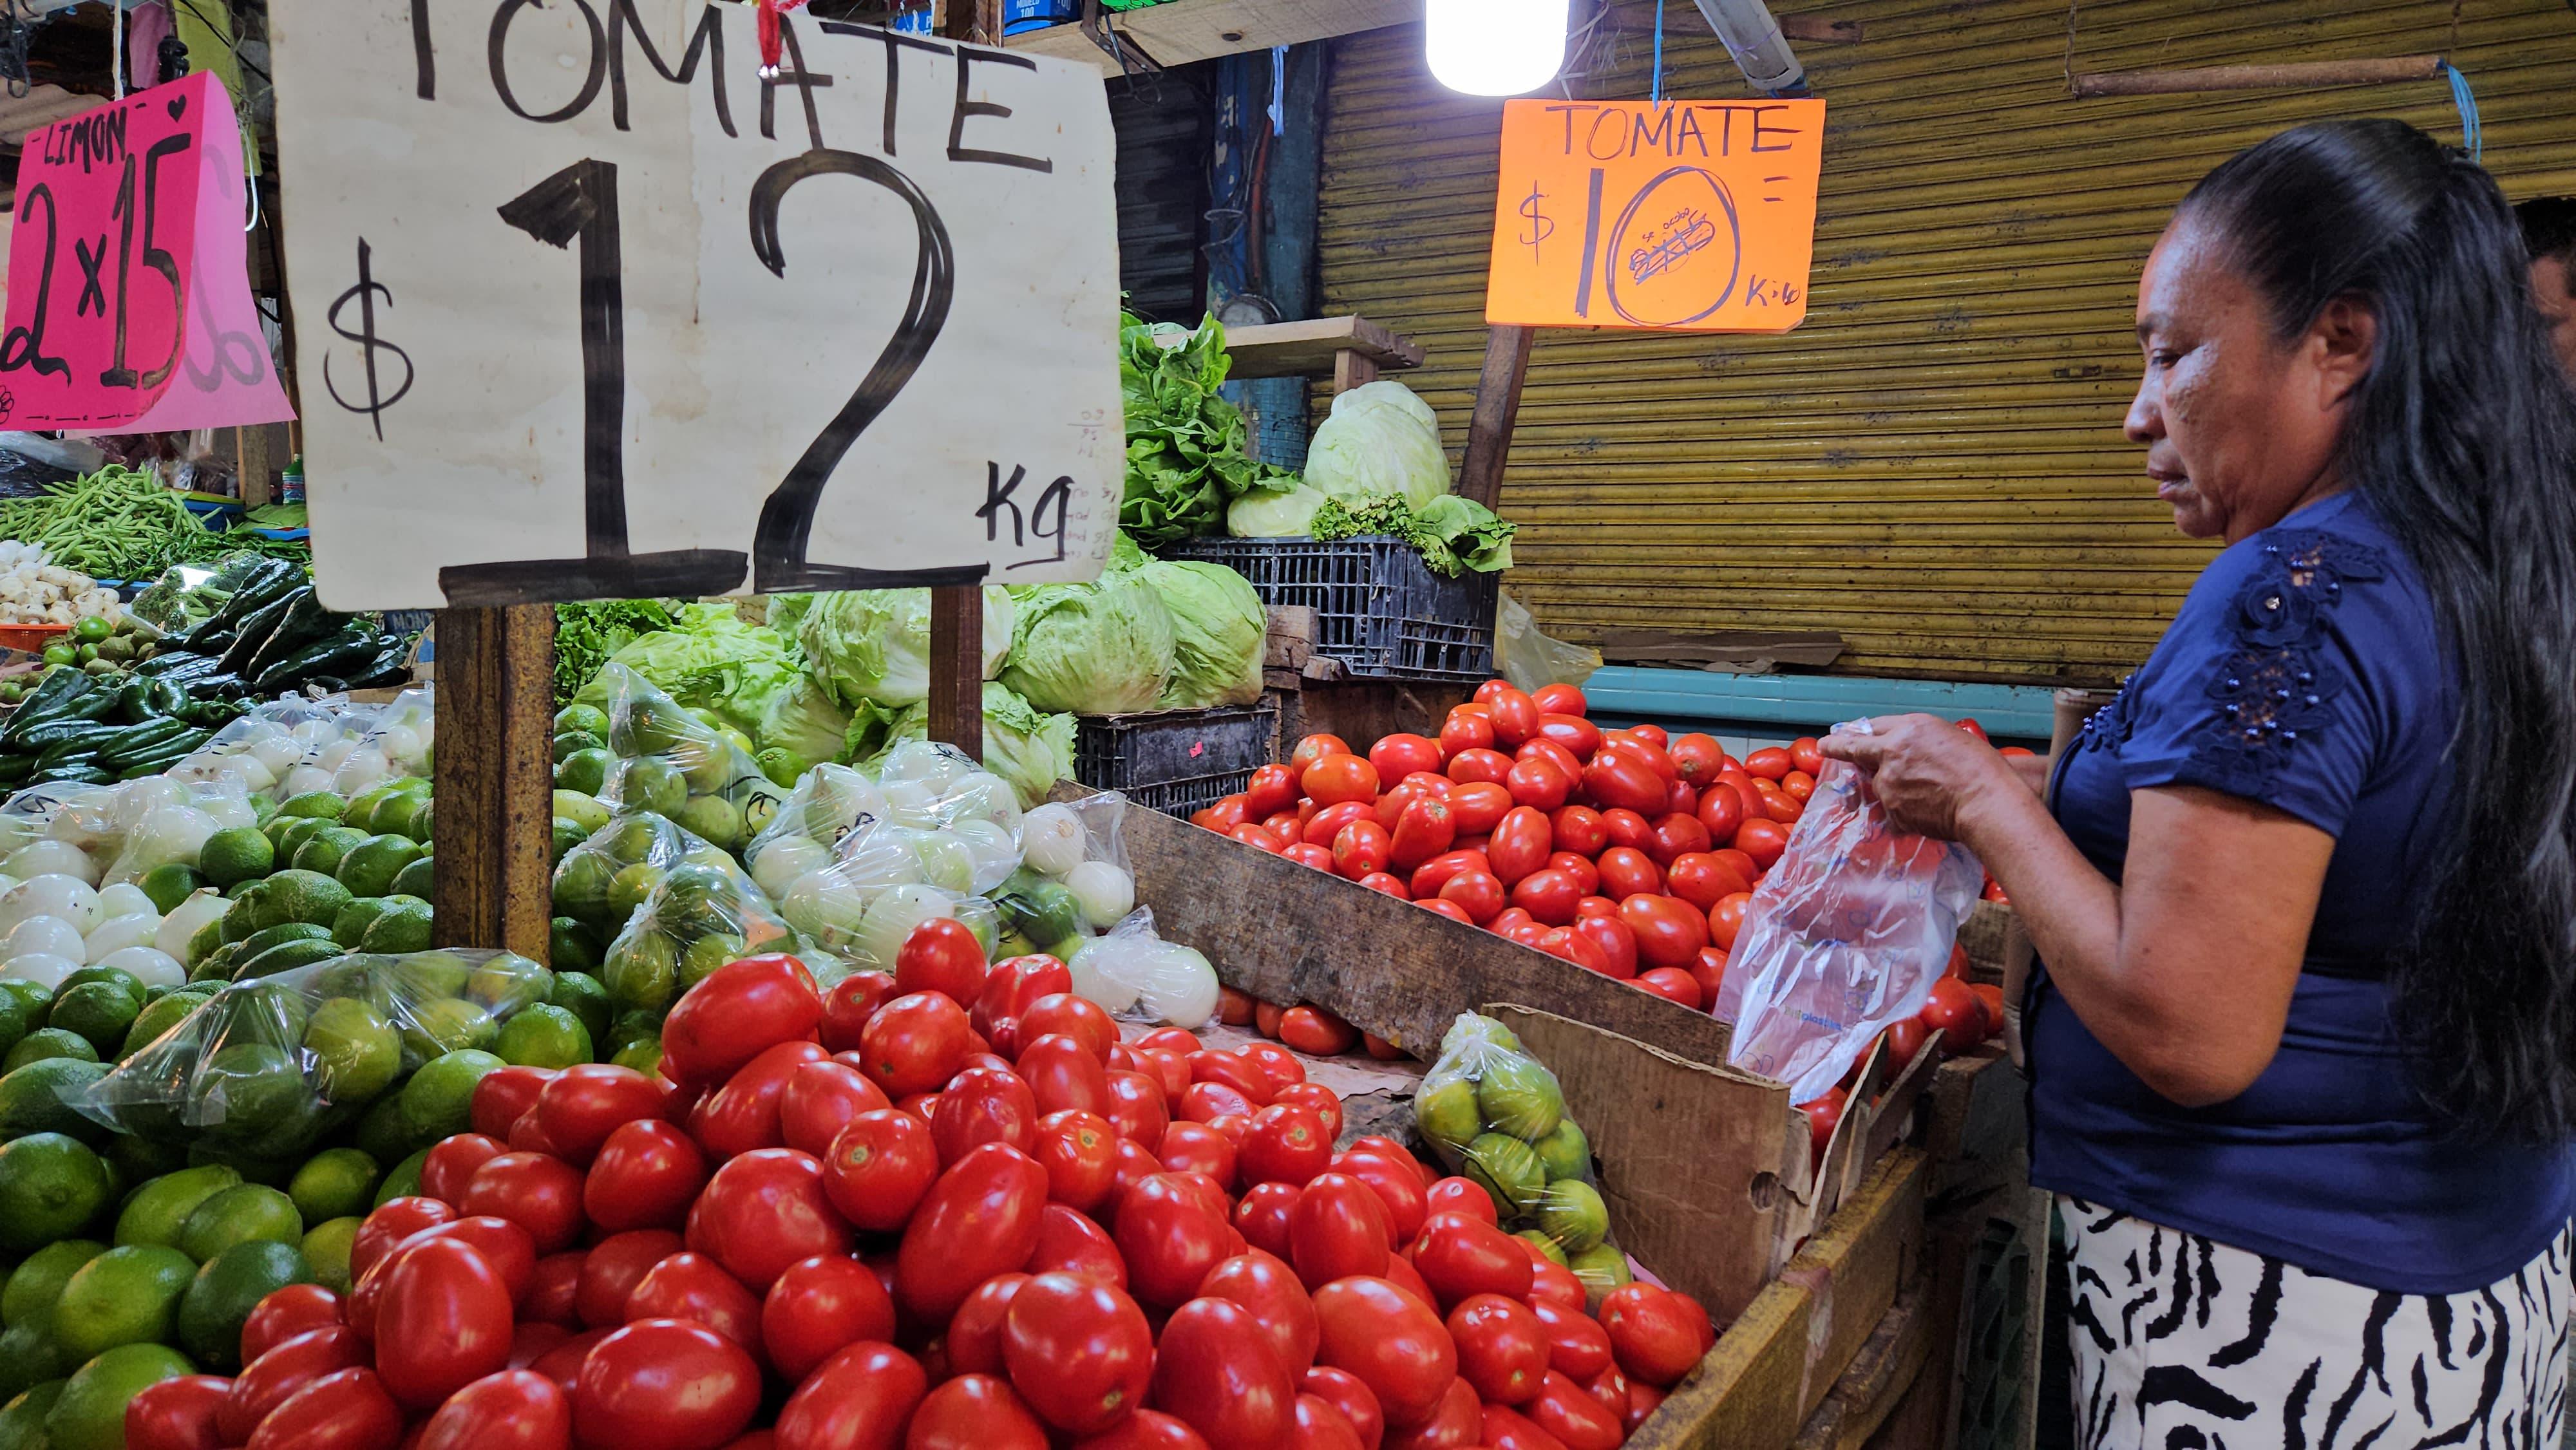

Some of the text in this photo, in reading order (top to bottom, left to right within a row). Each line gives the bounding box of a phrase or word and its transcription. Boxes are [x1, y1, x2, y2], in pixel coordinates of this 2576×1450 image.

[1021, 6, 1035, 18] 100
[44, 106, 128, 174] LIMON
[1545, 105, 1802, 160] TOMATE
[1575, 165, 1740, 326] 10
[440, 149, 992, 610] 12
[974, 460, 1075, 570] Kg
